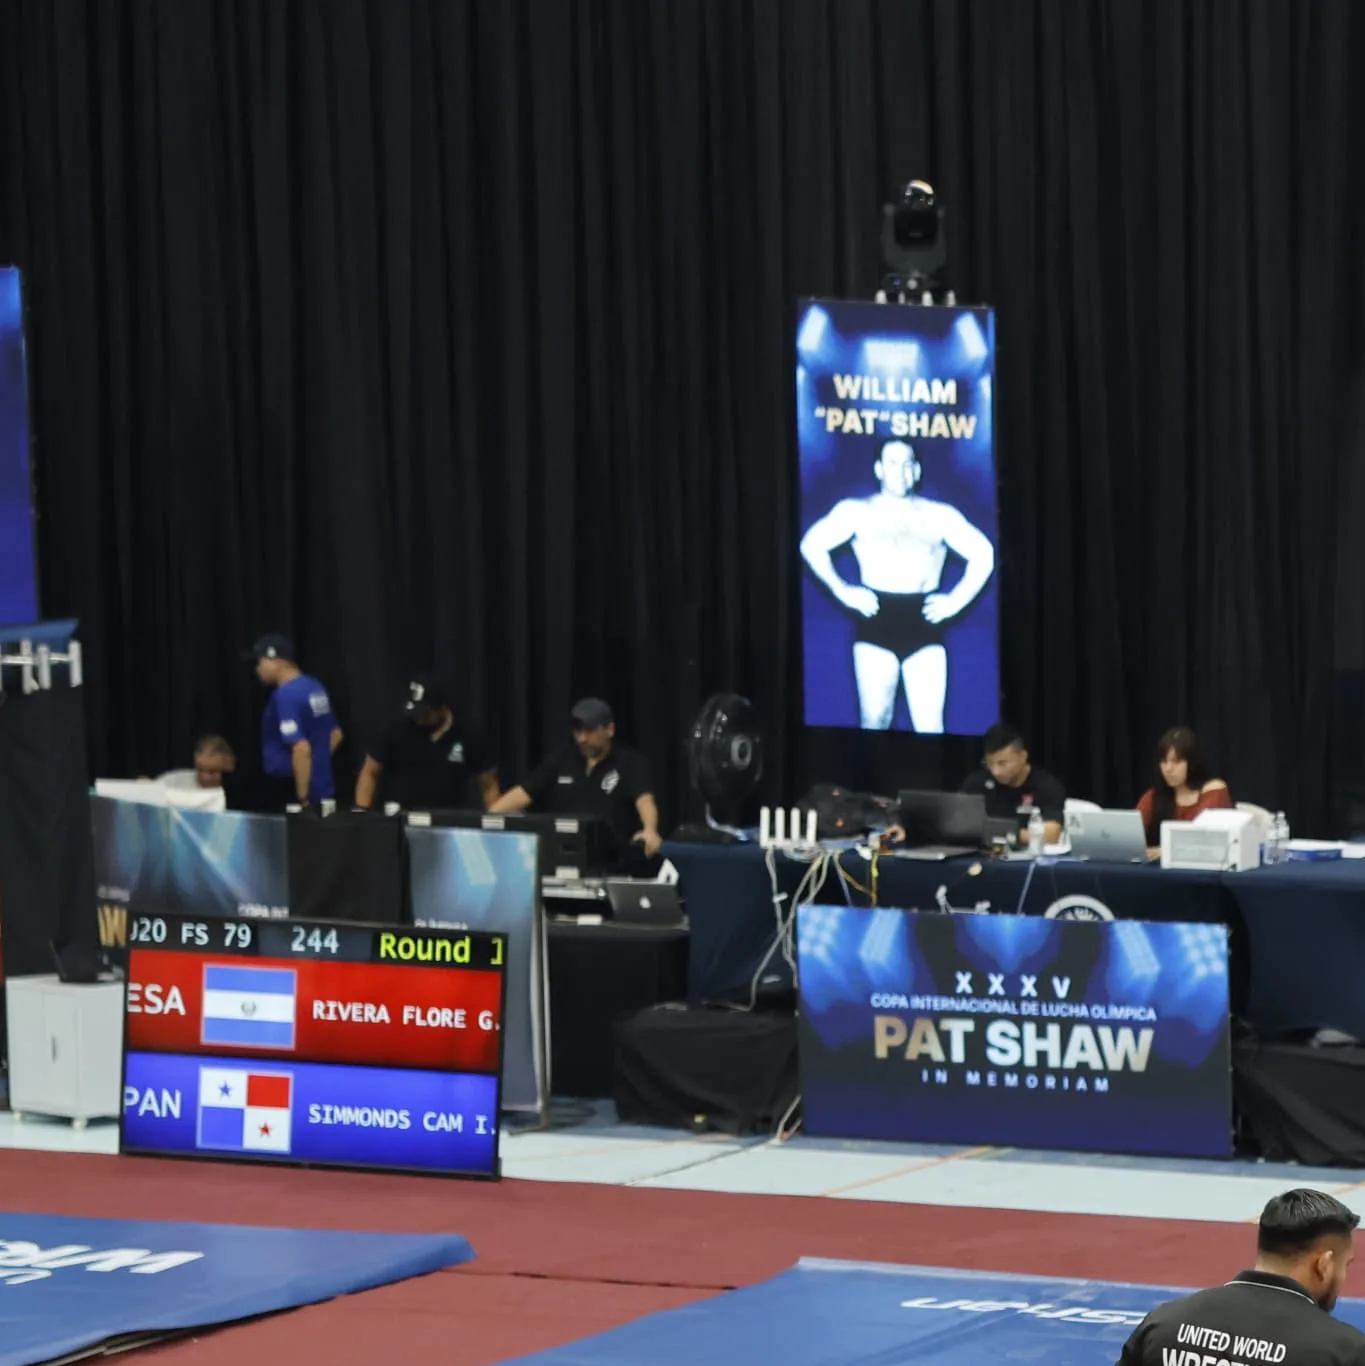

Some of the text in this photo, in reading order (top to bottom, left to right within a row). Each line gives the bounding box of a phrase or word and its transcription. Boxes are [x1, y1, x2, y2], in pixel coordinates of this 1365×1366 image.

[832, 373, 957, 405] WILLIAM
[181, 922, 209, 945] FS
[224, 922, 252, 948] 79
[291, 926, 339, 954] 244
[380, 933, 471, 964] Round
[127, 982, 187, 1016] ESA
[312, 1000, 390, 1024] RIVERA
[402, 1005, 466, 1030] FLORE
[871, 993, 909, 1009] COPA
[911, 995, 1018, 1015] INTERNACIONAL
[1021, 1002, 1038, 1016] DE
[1041, 1002, 1089, 1018] LUCHA
[874, 1016, 1154, 1072] PAT SHAW
[922, 1069, 1110, 1092] IN MEMORIAM
[124, 1085, 182, 1119] PAN
[309, 1104, 410, 1131] SIMMONDS
[422, 1112, 463, 1133] CAM
[1177, 1323, 1286, 1363] UNITED WORLD
